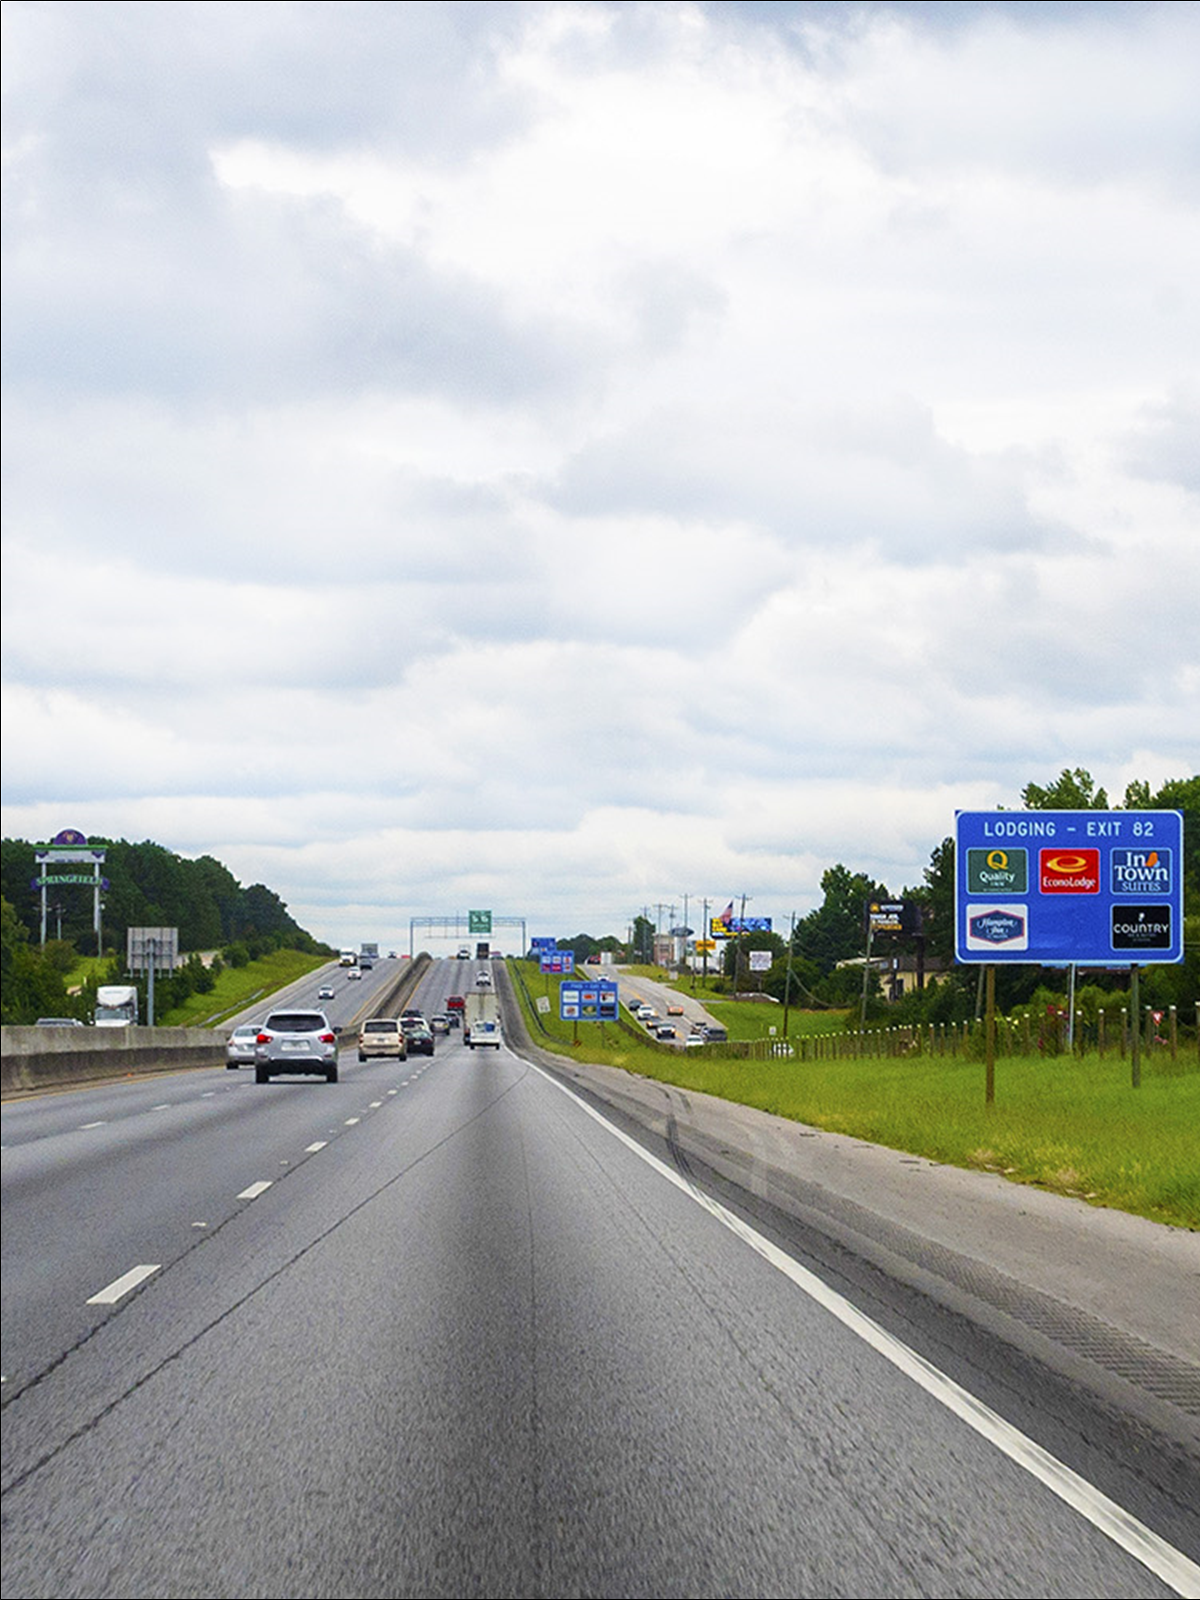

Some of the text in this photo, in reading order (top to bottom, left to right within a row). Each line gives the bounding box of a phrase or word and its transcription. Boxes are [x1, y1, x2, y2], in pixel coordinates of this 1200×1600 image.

[984, 821, 1057, 837] LODGING
[1086, 821, 1122, 837] EXIT
[1132, 821, 1155, 837] 82
[1126, 851, 1146, 867] In
[979, 871, 1015, 883] Quality
[1114, 865, 1168, 881] Town
[1113, 923, 1169, 934] COUNTRY
